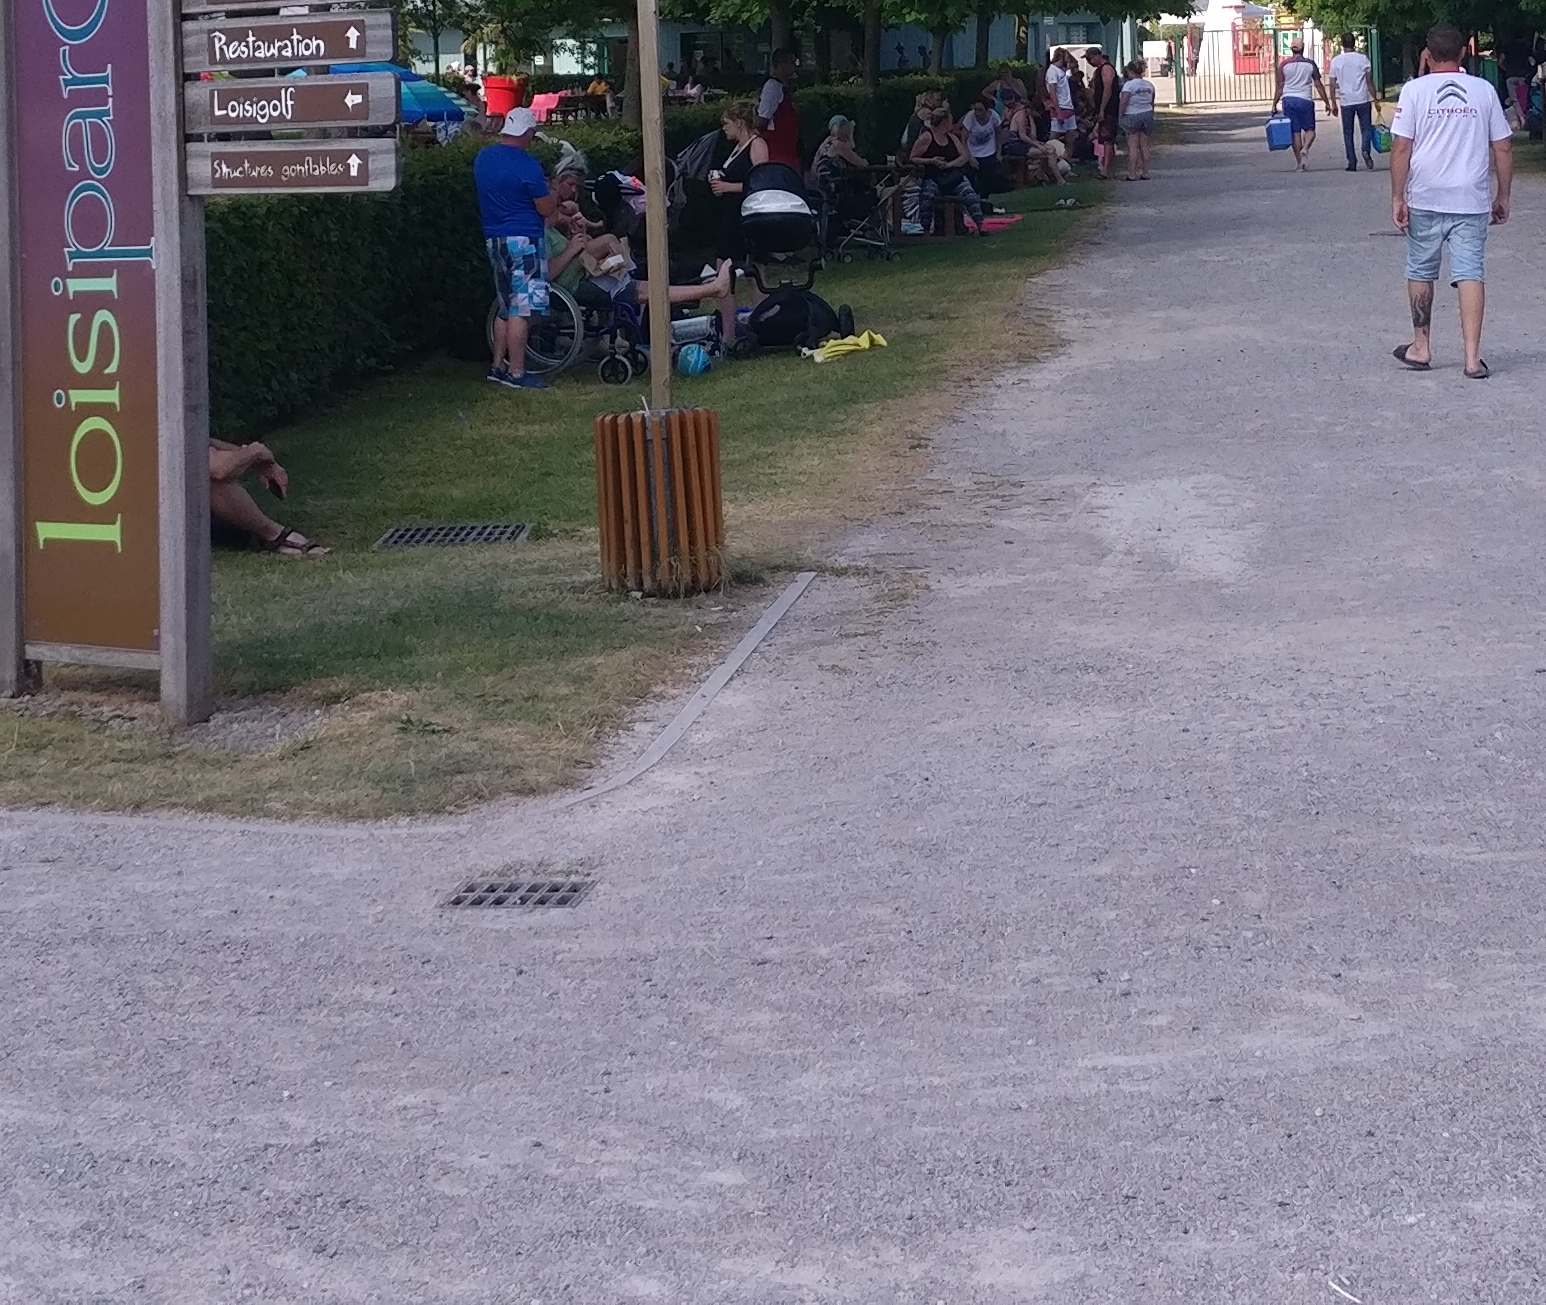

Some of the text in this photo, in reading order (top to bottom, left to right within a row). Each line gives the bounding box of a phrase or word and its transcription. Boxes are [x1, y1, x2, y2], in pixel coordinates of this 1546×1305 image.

[210, 27, 325, 63] Restauration
[213, 87, 295, 124] Loisigolf
[213, 159, 274, 179] Structures
